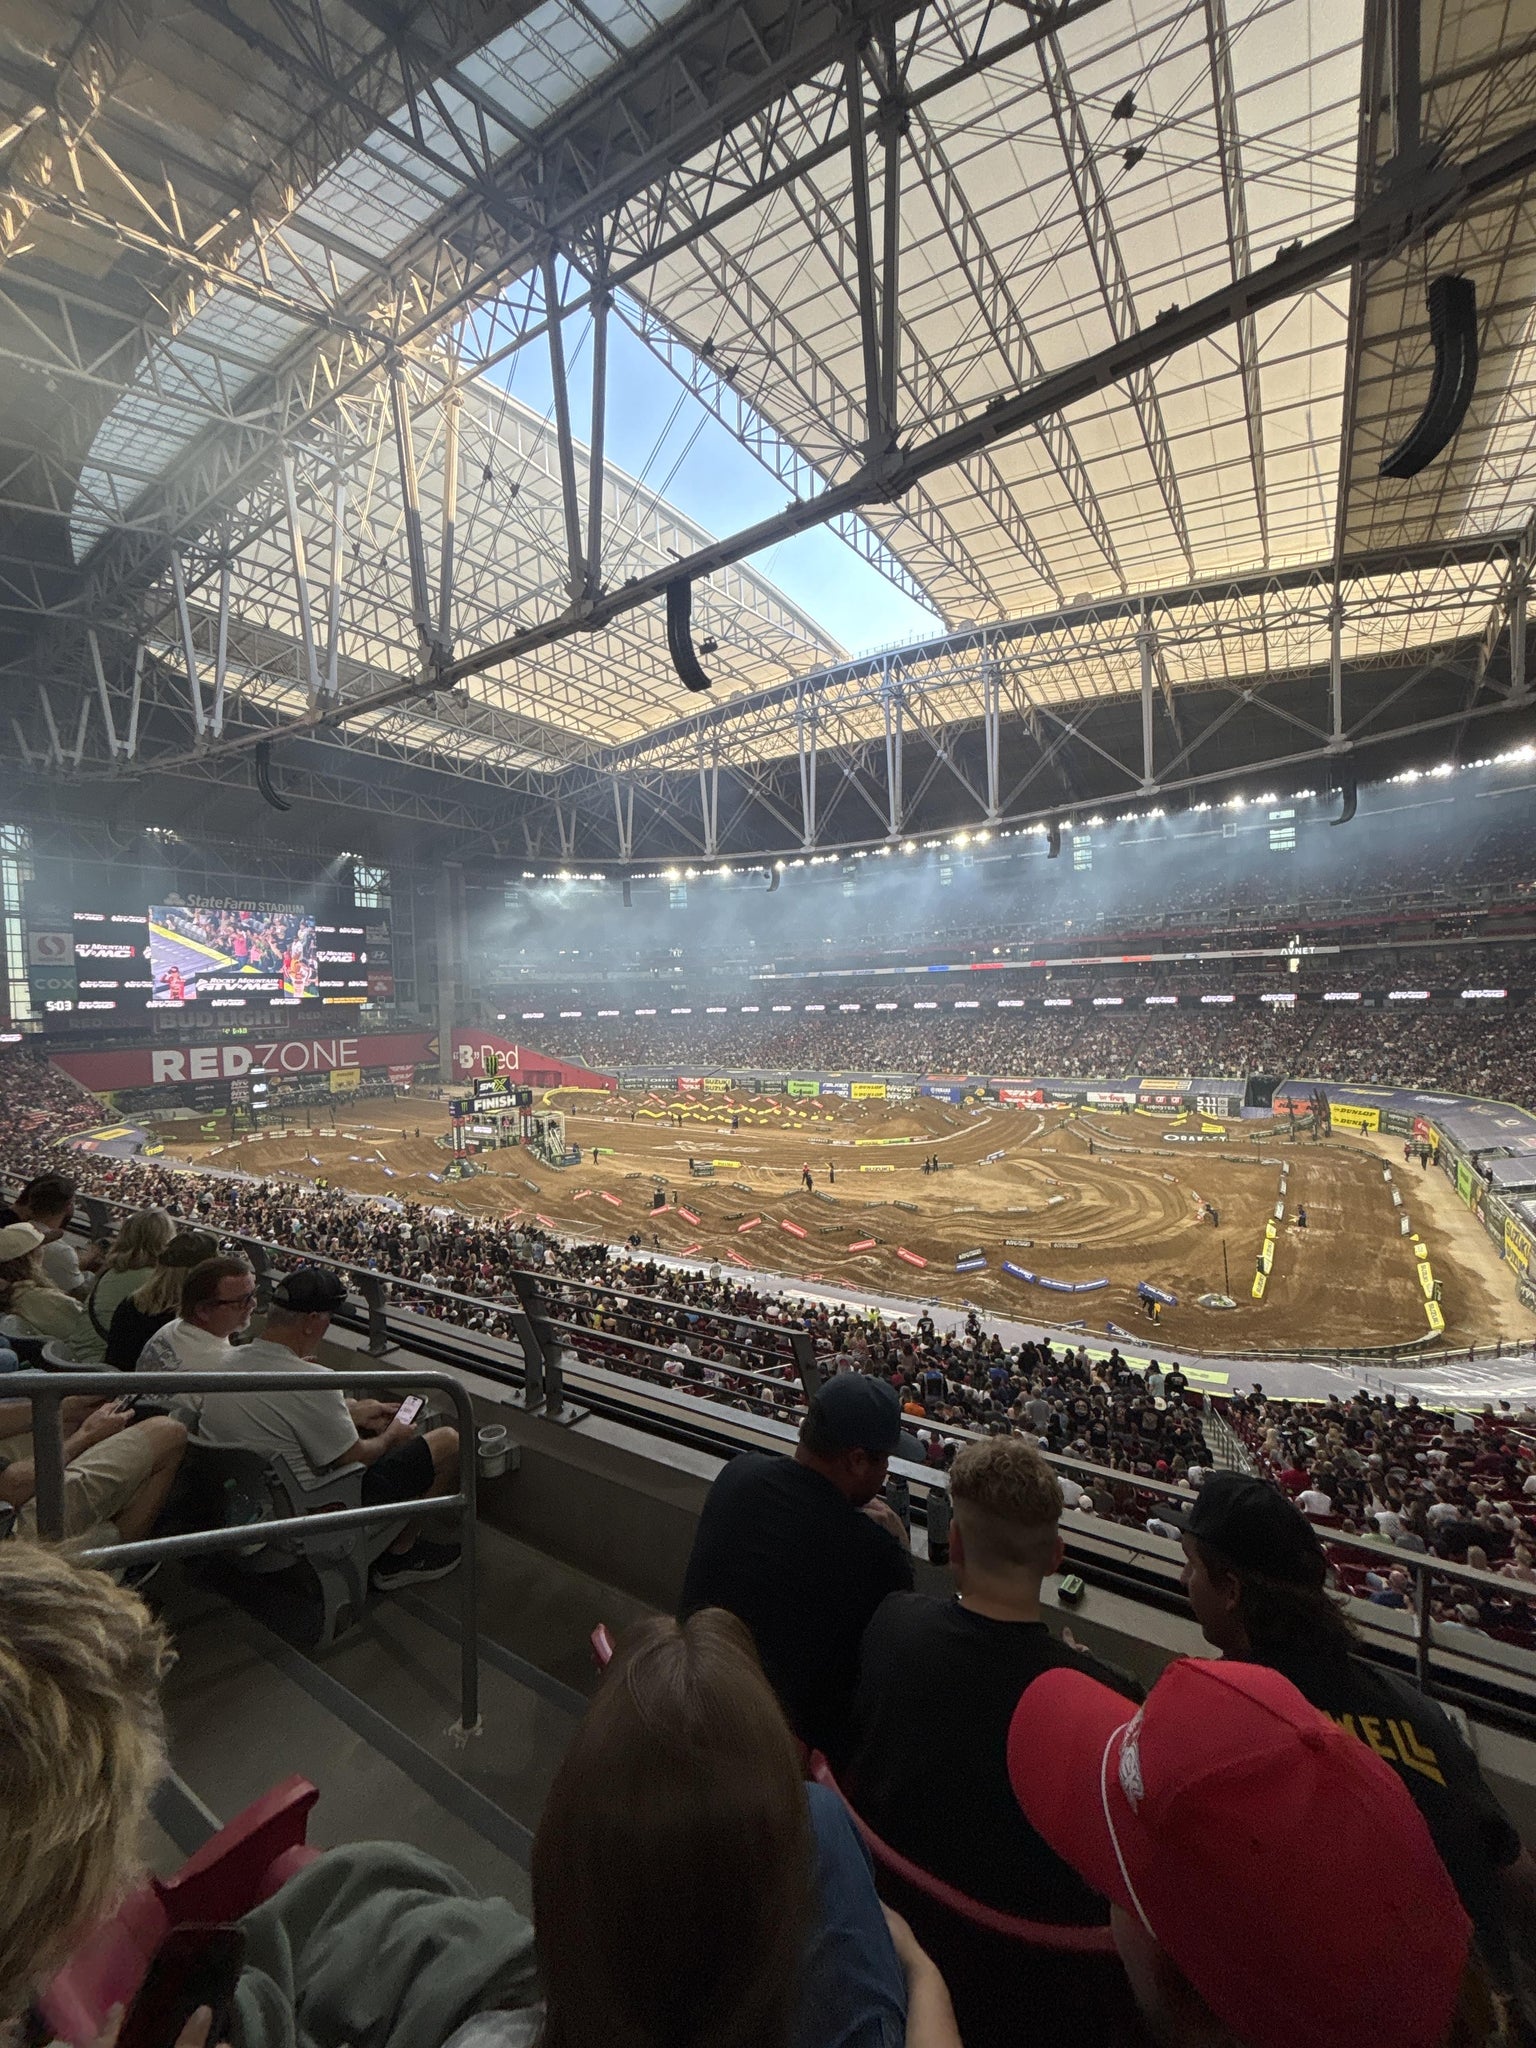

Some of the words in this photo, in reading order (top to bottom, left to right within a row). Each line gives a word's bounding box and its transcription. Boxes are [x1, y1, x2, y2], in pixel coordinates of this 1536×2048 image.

[258, 903, 305, 914] STADIUM
[34, 979, 75, 990] COX
[45, 1001, 73, 1012] 5:03
[159, 1010, 213, 1028] BUD
[217, 1009, 281, 1026] LIGHT
[480, 1078, 508, 1091] SMX
[473, 1094, 517, 1111] FINISH
[1339, 1108, 1376, 1117] DUNLOP
